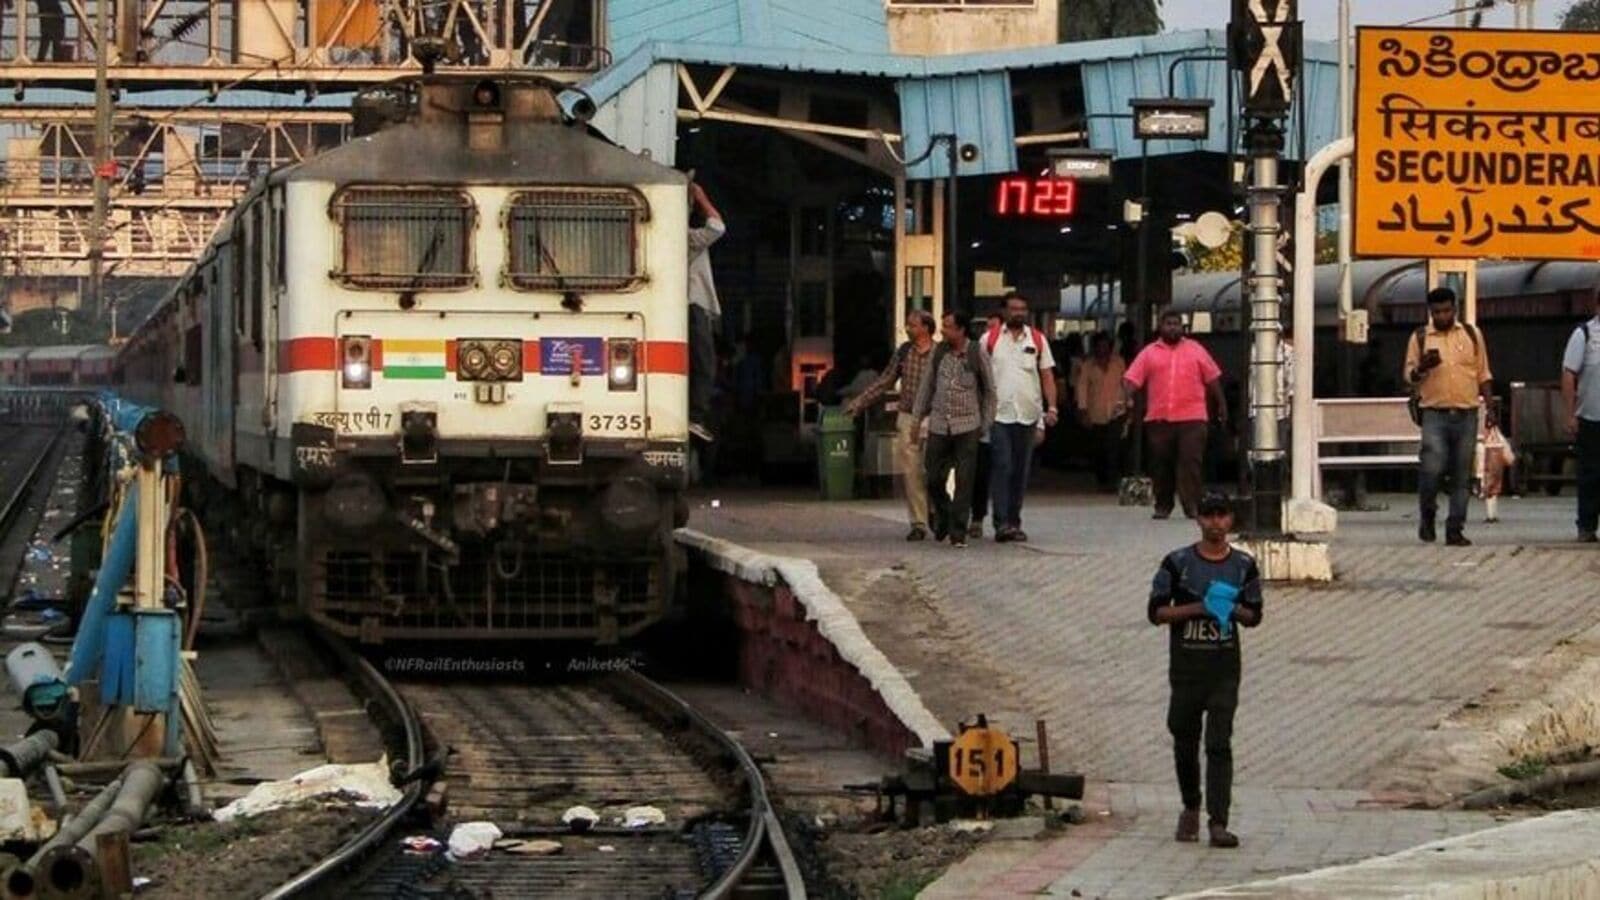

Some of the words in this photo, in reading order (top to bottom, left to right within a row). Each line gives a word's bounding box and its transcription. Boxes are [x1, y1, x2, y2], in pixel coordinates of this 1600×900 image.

[1375, 150, 1600, 186] SECUNDERA
[1377, 187, 1600, 246] کندرآباد
[366, 406, 380, 429] पी
[384, 413, 392, 429] 7
[589, 415, 652, 431] 37351
[955, 748, 1004, 777] 151
